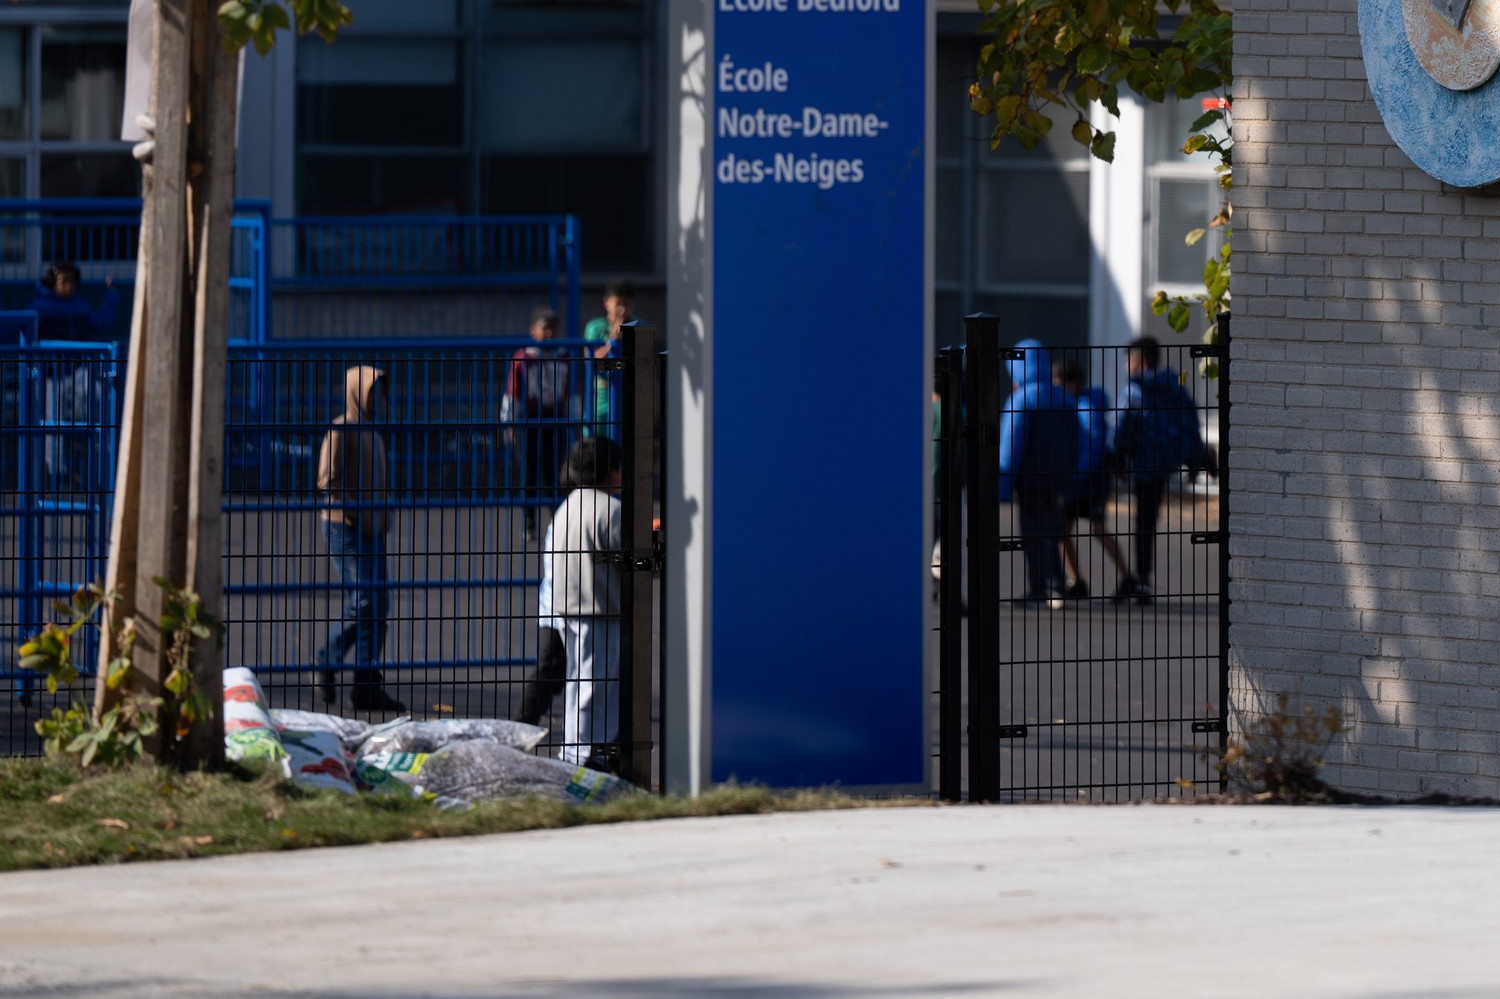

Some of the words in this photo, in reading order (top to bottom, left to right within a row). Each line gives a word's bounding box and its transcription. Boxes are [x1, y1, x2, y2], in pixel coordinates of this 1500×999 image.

[719, 54, 788, 92] École
[718, 107, 889, 137] Notre-Dame-
[718, 153, 864, 189] des-Neiges
